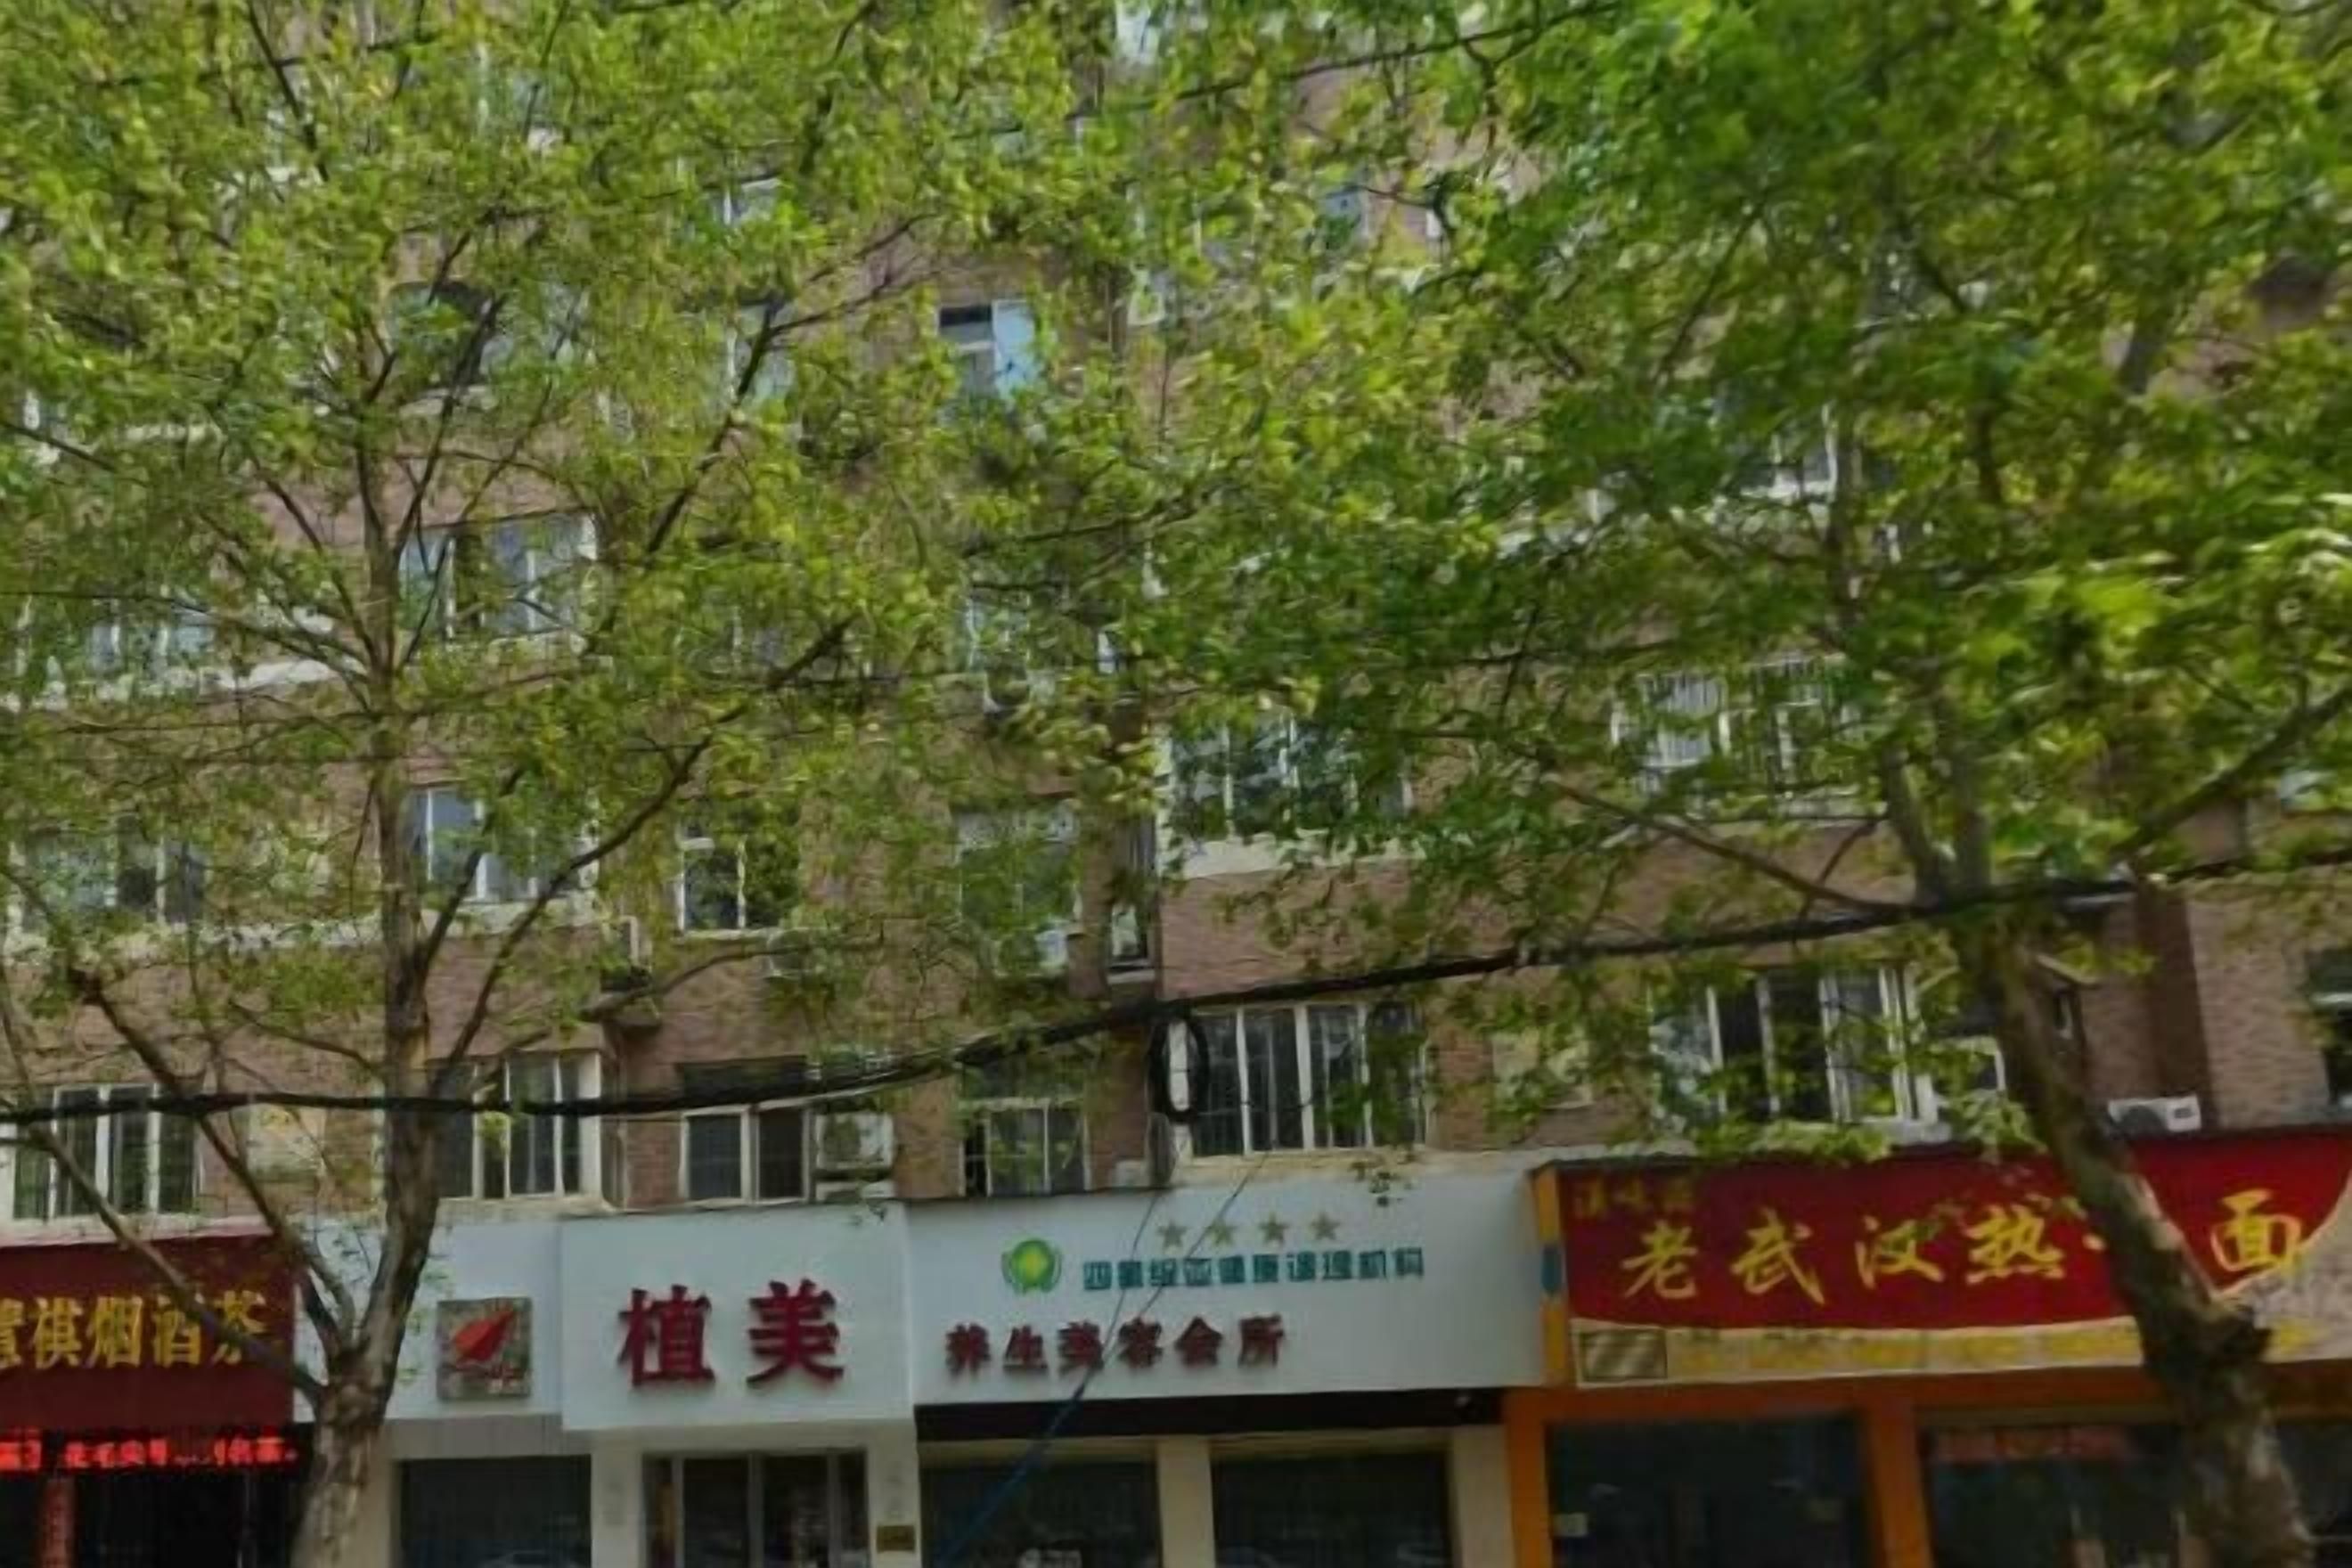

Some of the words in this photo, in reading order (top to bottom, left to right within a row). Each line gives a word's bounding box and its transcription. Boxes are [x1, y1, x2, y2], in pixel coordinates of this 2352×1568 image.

[1621, 1188, 2300, 1305] 老武汉热面
[617, 1278, 845, 1388] 植美
